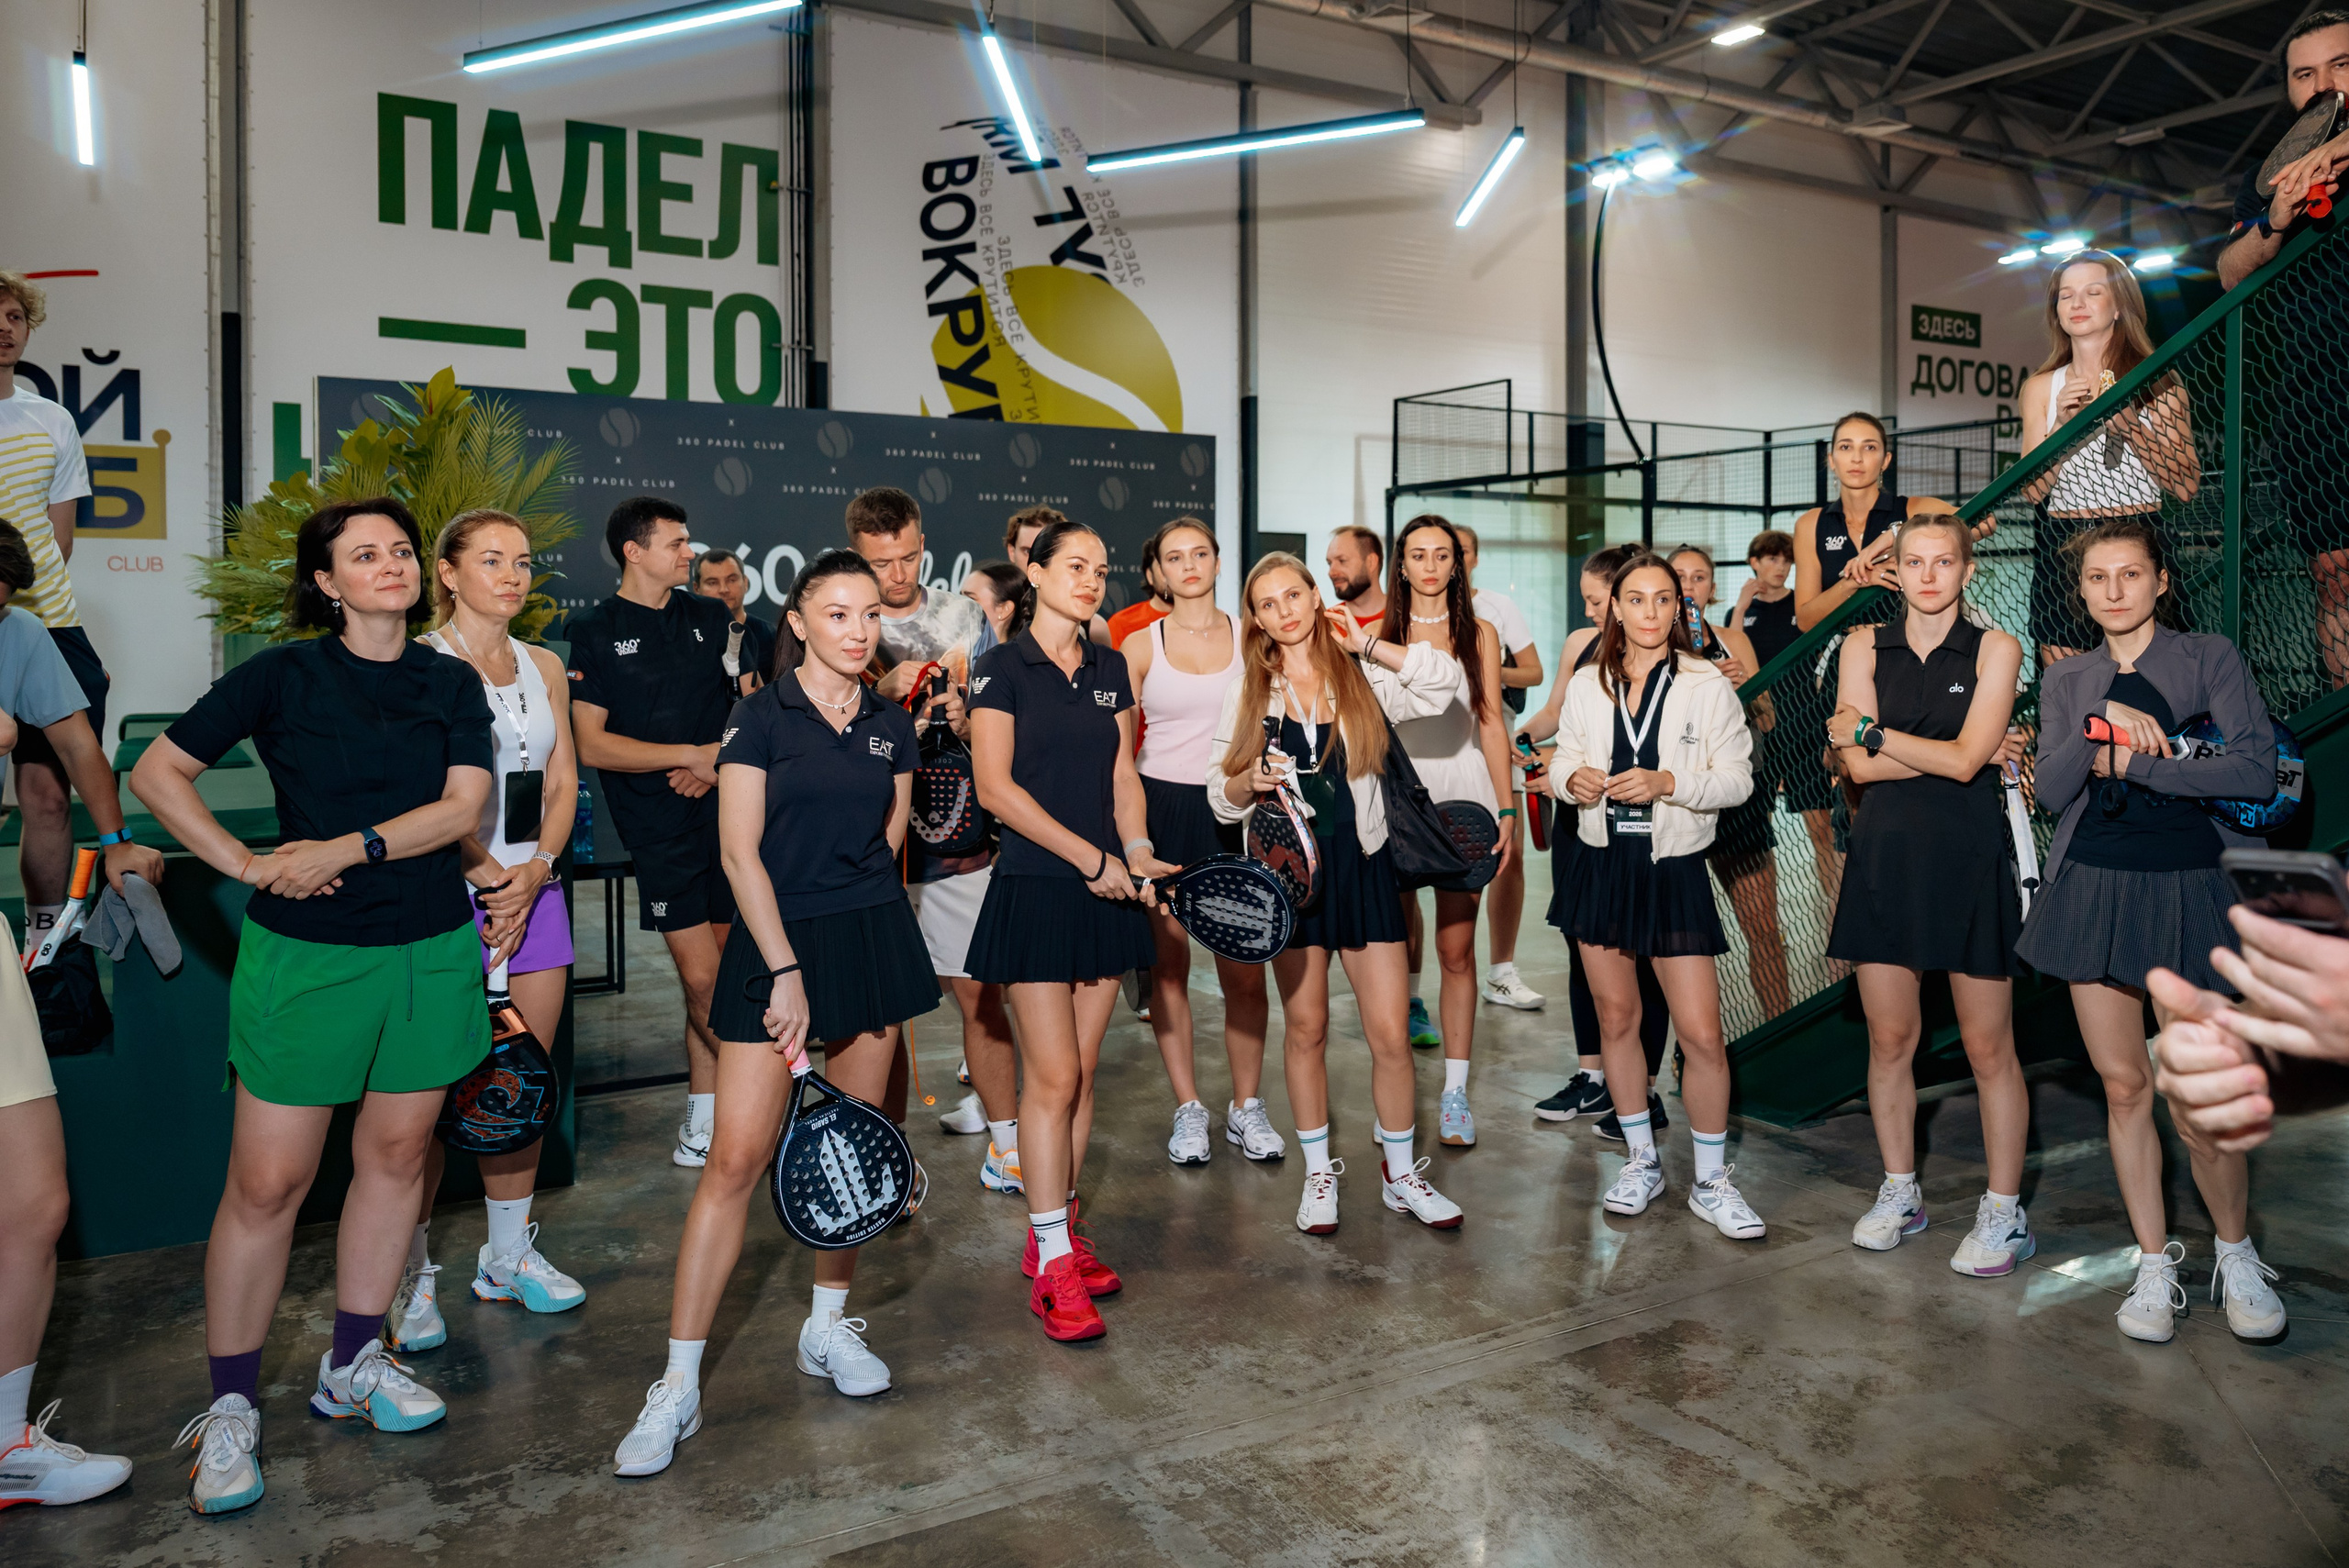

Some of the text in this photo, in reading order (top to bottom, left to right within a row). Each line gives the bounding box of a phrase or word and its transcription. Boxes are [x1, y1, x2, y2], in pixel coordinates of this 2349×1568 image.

[377, 92, 780, 270] ПАДЕЛ
[981, 244, 1008, 348] КРУТИТСЯ
[1918, 313, 1977, 340] ЗДЕСЬ
[566, 278, 783, 408] ЭТО
[1015, 353, 1041, 423] КРУТИ
[527, 428, 563, 439] CLUB
[677, 437, 785, 450] 360 PADEL CLUB
[885, 448, 981, 462] 360 PADEL CLUB
[1070, 458, 1155, 471] 360 PADEL CLUB
[593, 476, 635, 487] PADEL
[641, 478, 675, 489] CLUB
[783, 484, 805, 494] 360
[810, 485, 847, 495] PADEL
[978, 493, 1069, 504] 360 PADEL CLUB
[1174, 501, 1205, 510] PADEL
[106, 555, 164, 573] CLUB
[537, 553, 563, 562] LUB
[561, 598, 585, 607] 360
[1949, 682, 1965, 693] alo
[1093, 690, 1118, 705] EA7
[811, 1113, 837, 1131] EL SABIO
